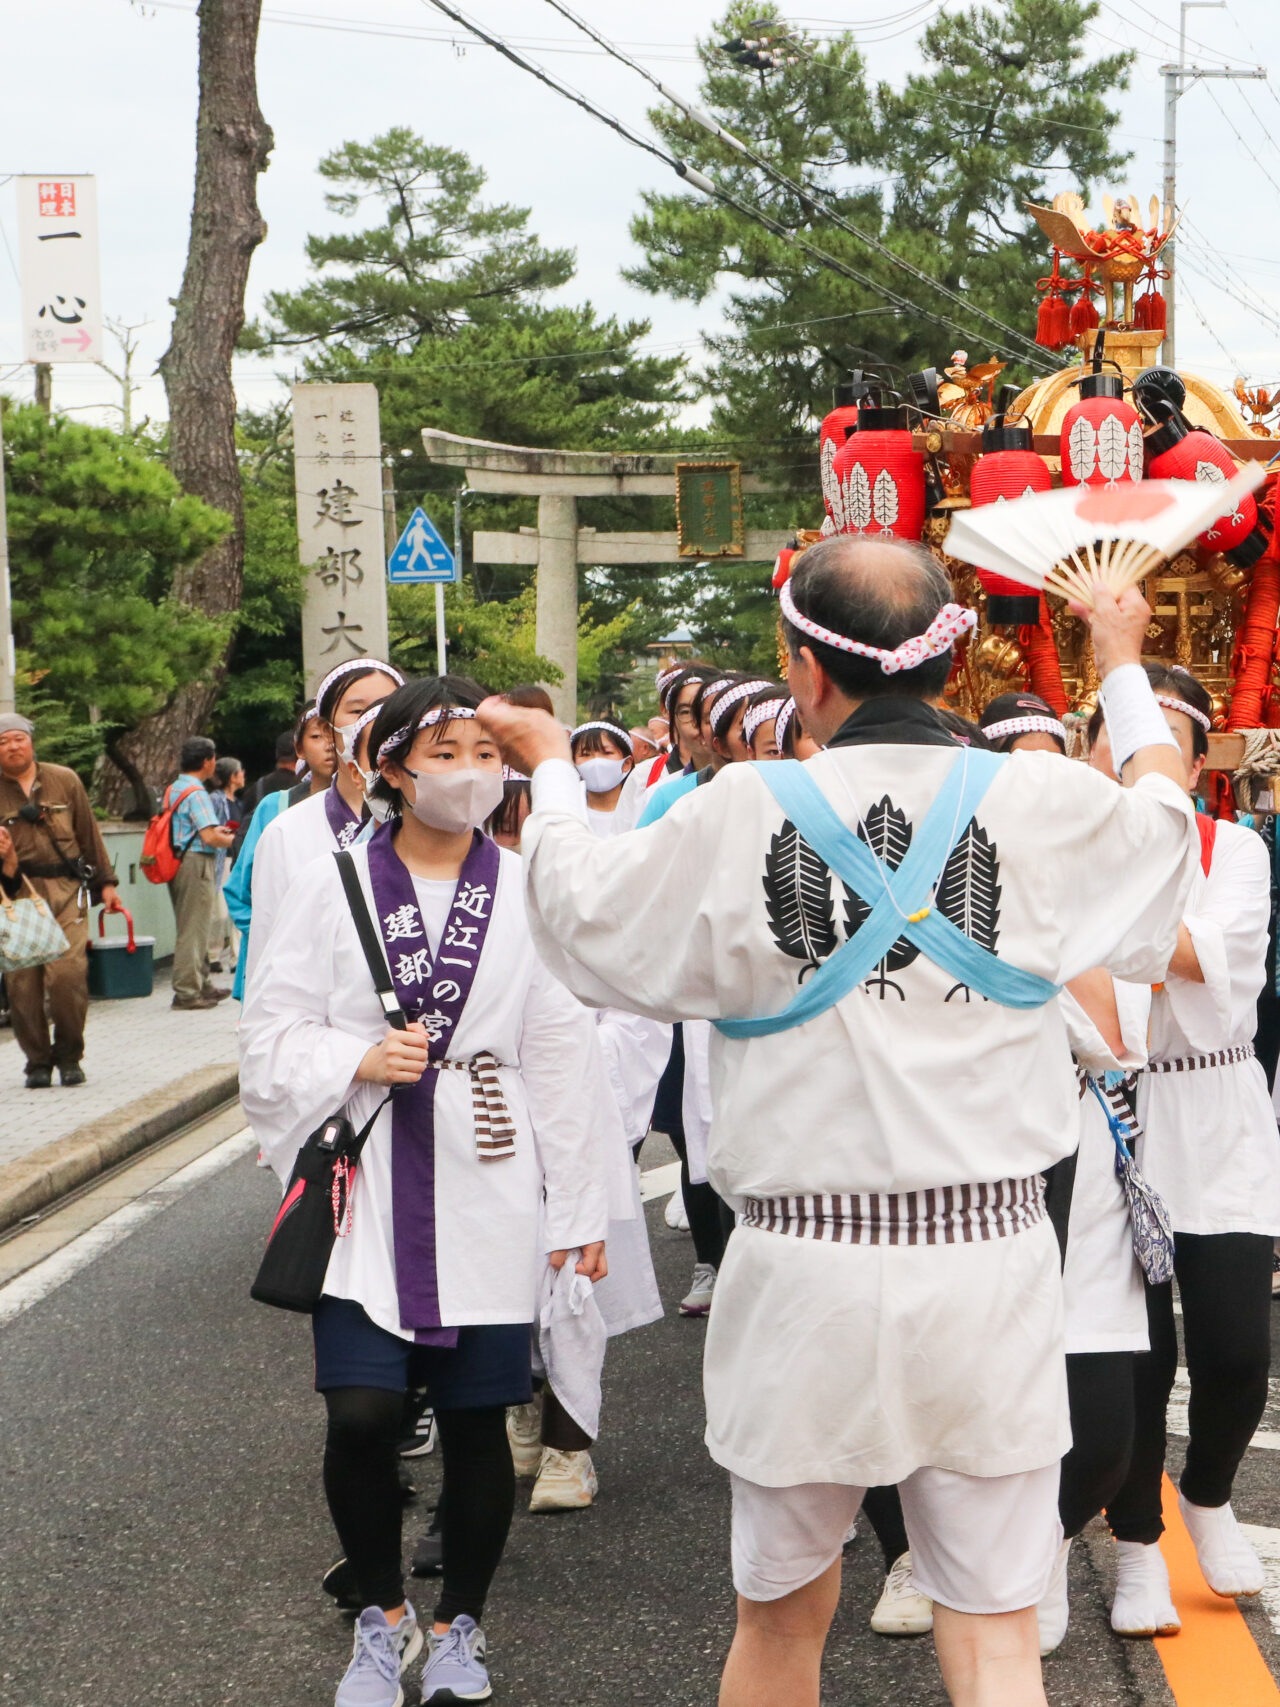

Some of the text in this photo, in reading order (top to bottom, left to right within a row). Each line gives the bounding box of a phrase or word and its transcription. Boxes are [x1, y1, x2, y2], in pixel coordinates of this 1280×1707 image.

[40, 183, 57, 215] 料理
[60, 183, 75, 216] 日本
[38, 231, 86, 324] 一心
[313, 478, 368, 656] 建部大
[384, 904, 432, 1011] 建部
[417, 882, 491, 1043] 近江一の宮
